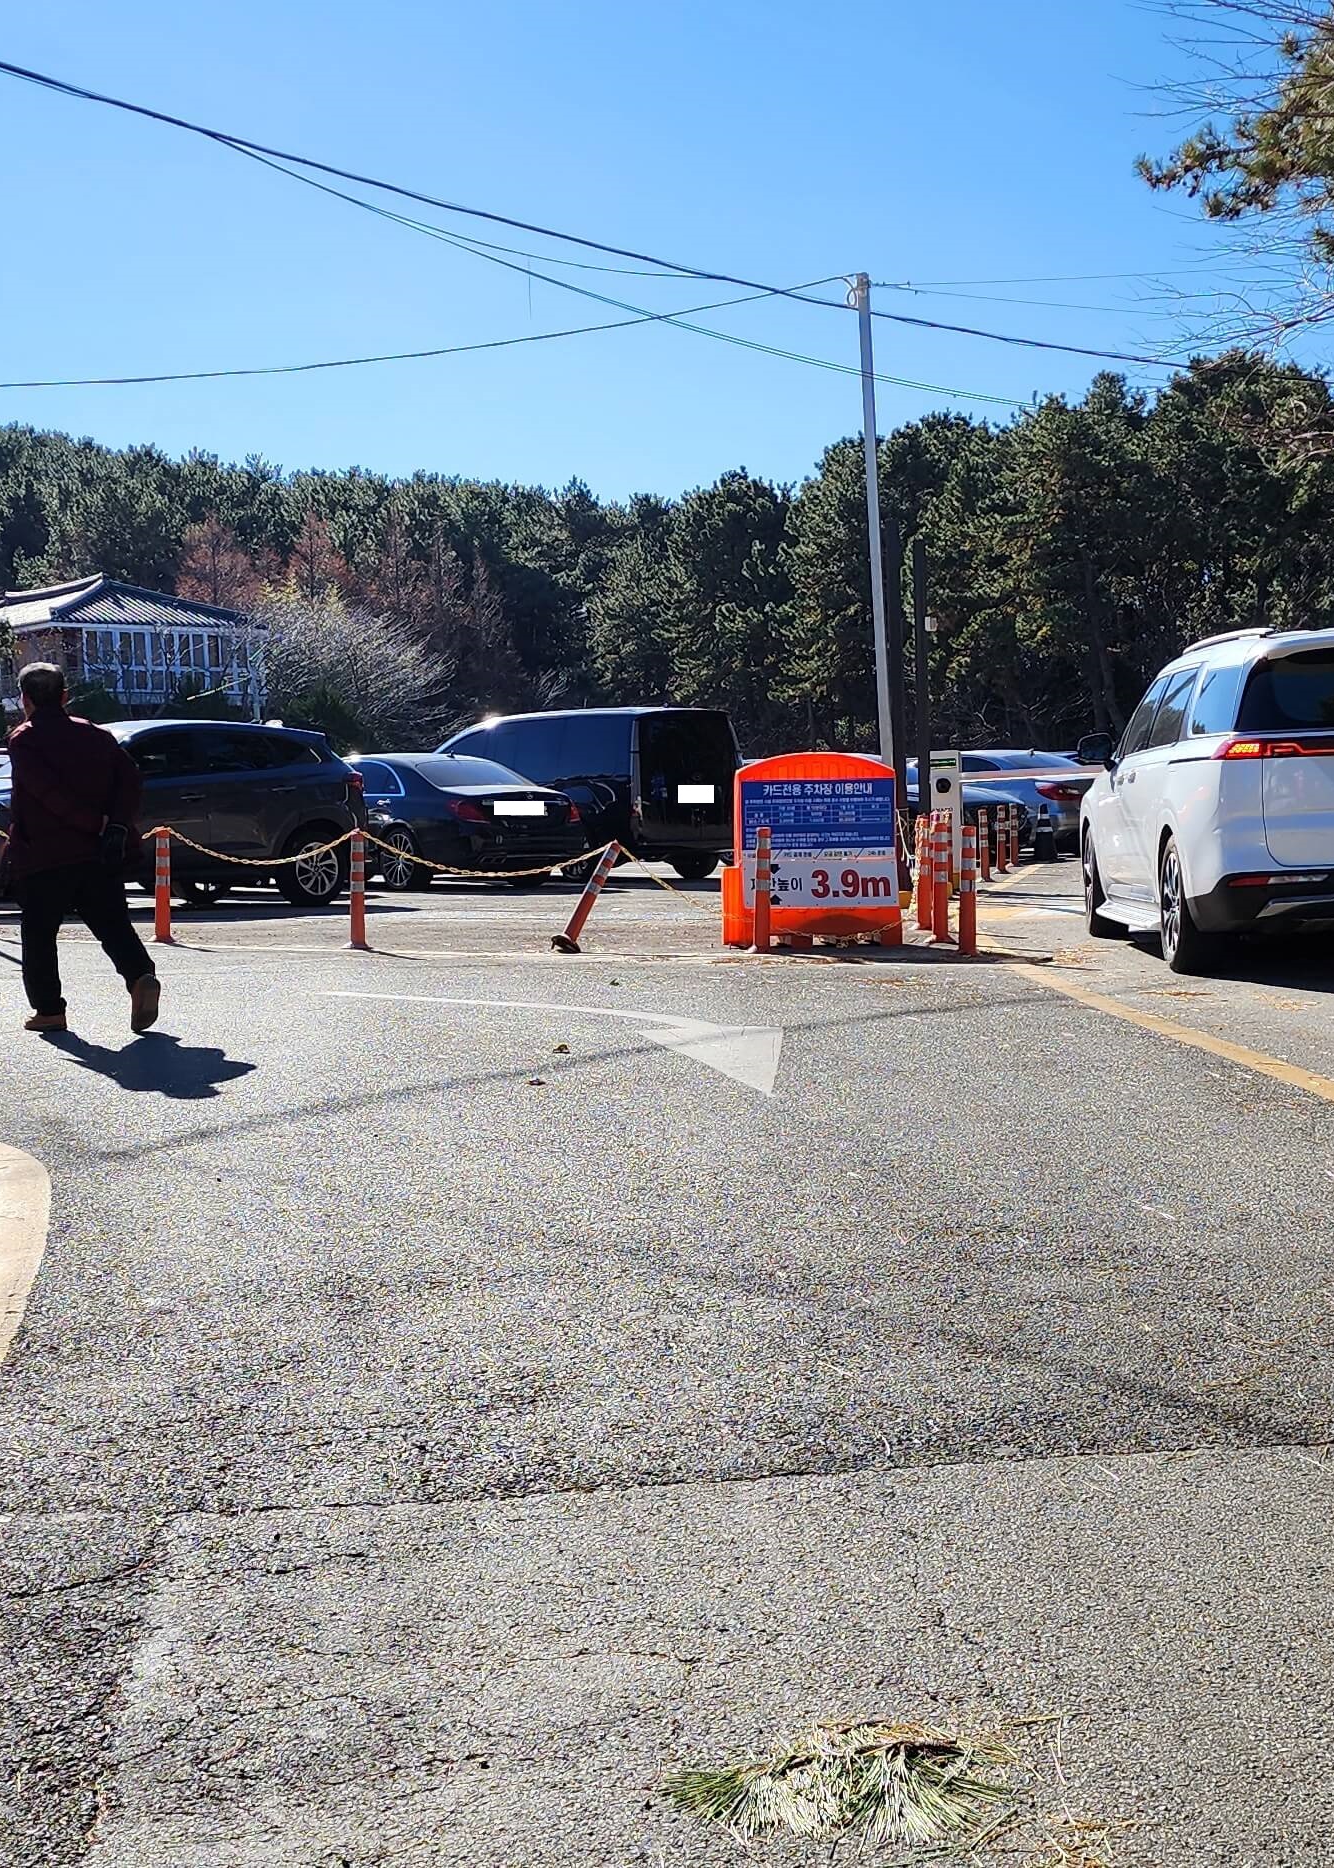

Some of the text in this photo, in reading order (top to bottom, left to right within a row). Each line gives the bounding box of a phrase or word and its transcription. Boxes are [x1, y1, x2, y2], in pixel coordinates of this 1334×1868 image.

[763, 782, 873, 796] 카드전용 주차장 이용안내
[811, 869, 892, 898] 3.9m
